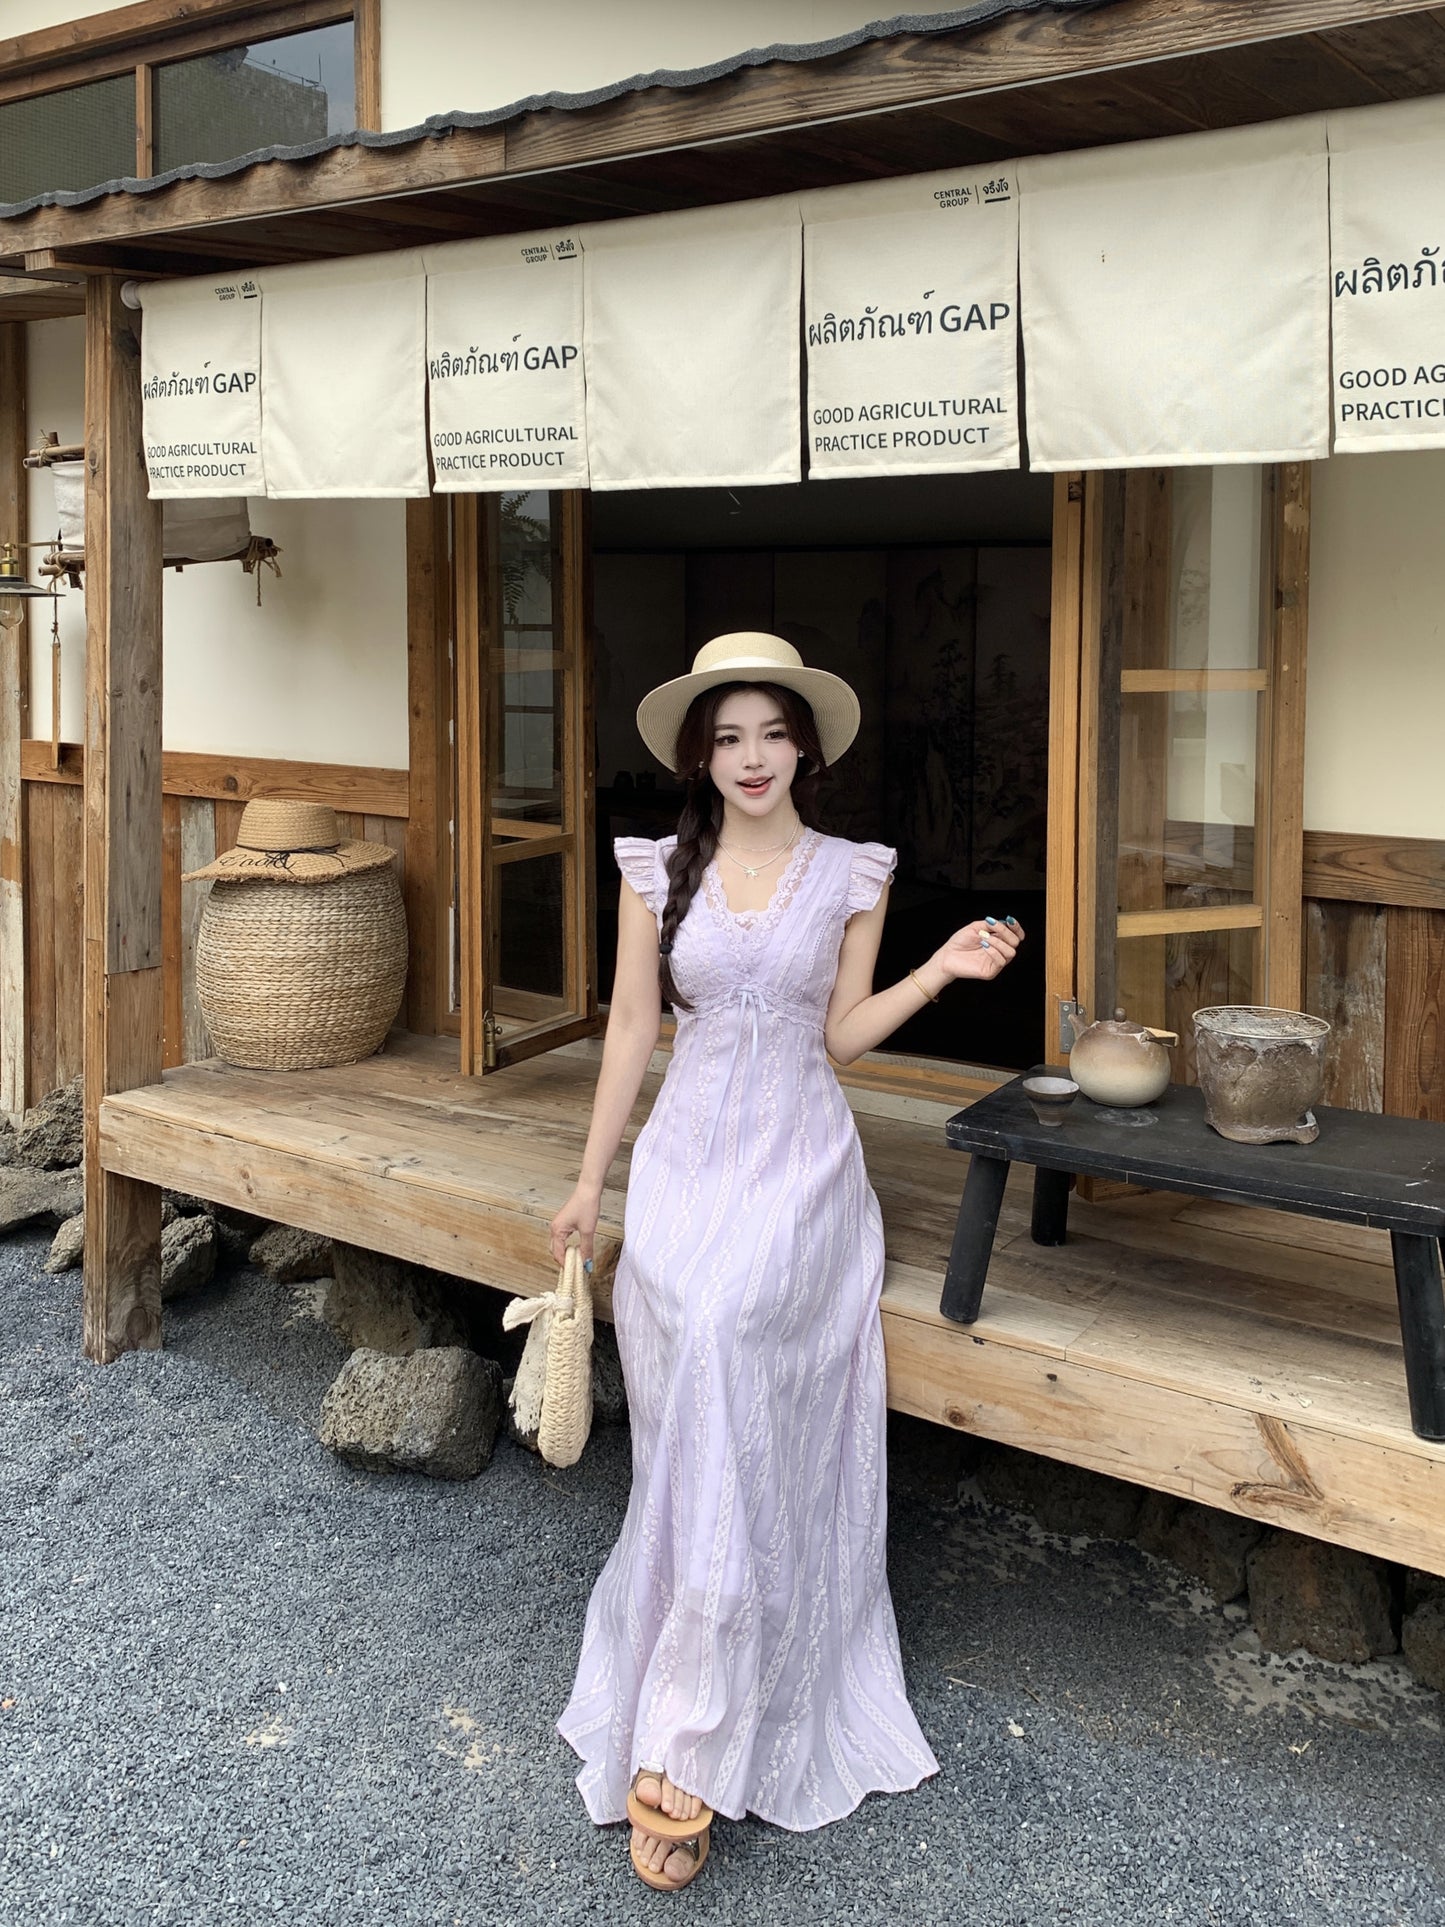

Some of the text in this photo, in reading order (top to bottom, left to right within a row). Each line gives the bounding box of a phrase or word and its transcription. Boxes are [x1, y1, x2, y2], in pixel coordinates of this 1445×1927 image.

[933, 187, 973, 200] CENTRAL
[939, 197, 970, 209] GROUP
[520, 246, 549, 257] CENTRAL
[525, 254, 548, 264] GROUP
[1334, 245, 1445, 299] ผลิตภั
[808, 289, 1011, 348] ผลิตภัณฑ์ GAP
[429, 333, 579, 382] ผลิตภัณฑ์ GAP
[143, 360, 257, 401] ผลิตภัณฑ์ GAP
[1339, 367, 1408, 390] GOOD
[813, 397, 1009, 426] GOOD AGRICULTURAL
[433, 425, 579, 447] GOOD AGRICULTURAL
[815, 427, 991, 454] PRACTICE PRODUCT
[147, 442, 258, 459] GOOD AGRICULTURAL
[436, 451, 566, 471] PRACTICE PRODUCT
[149, 463, 247, 479] PRACTICE PRODUCT
